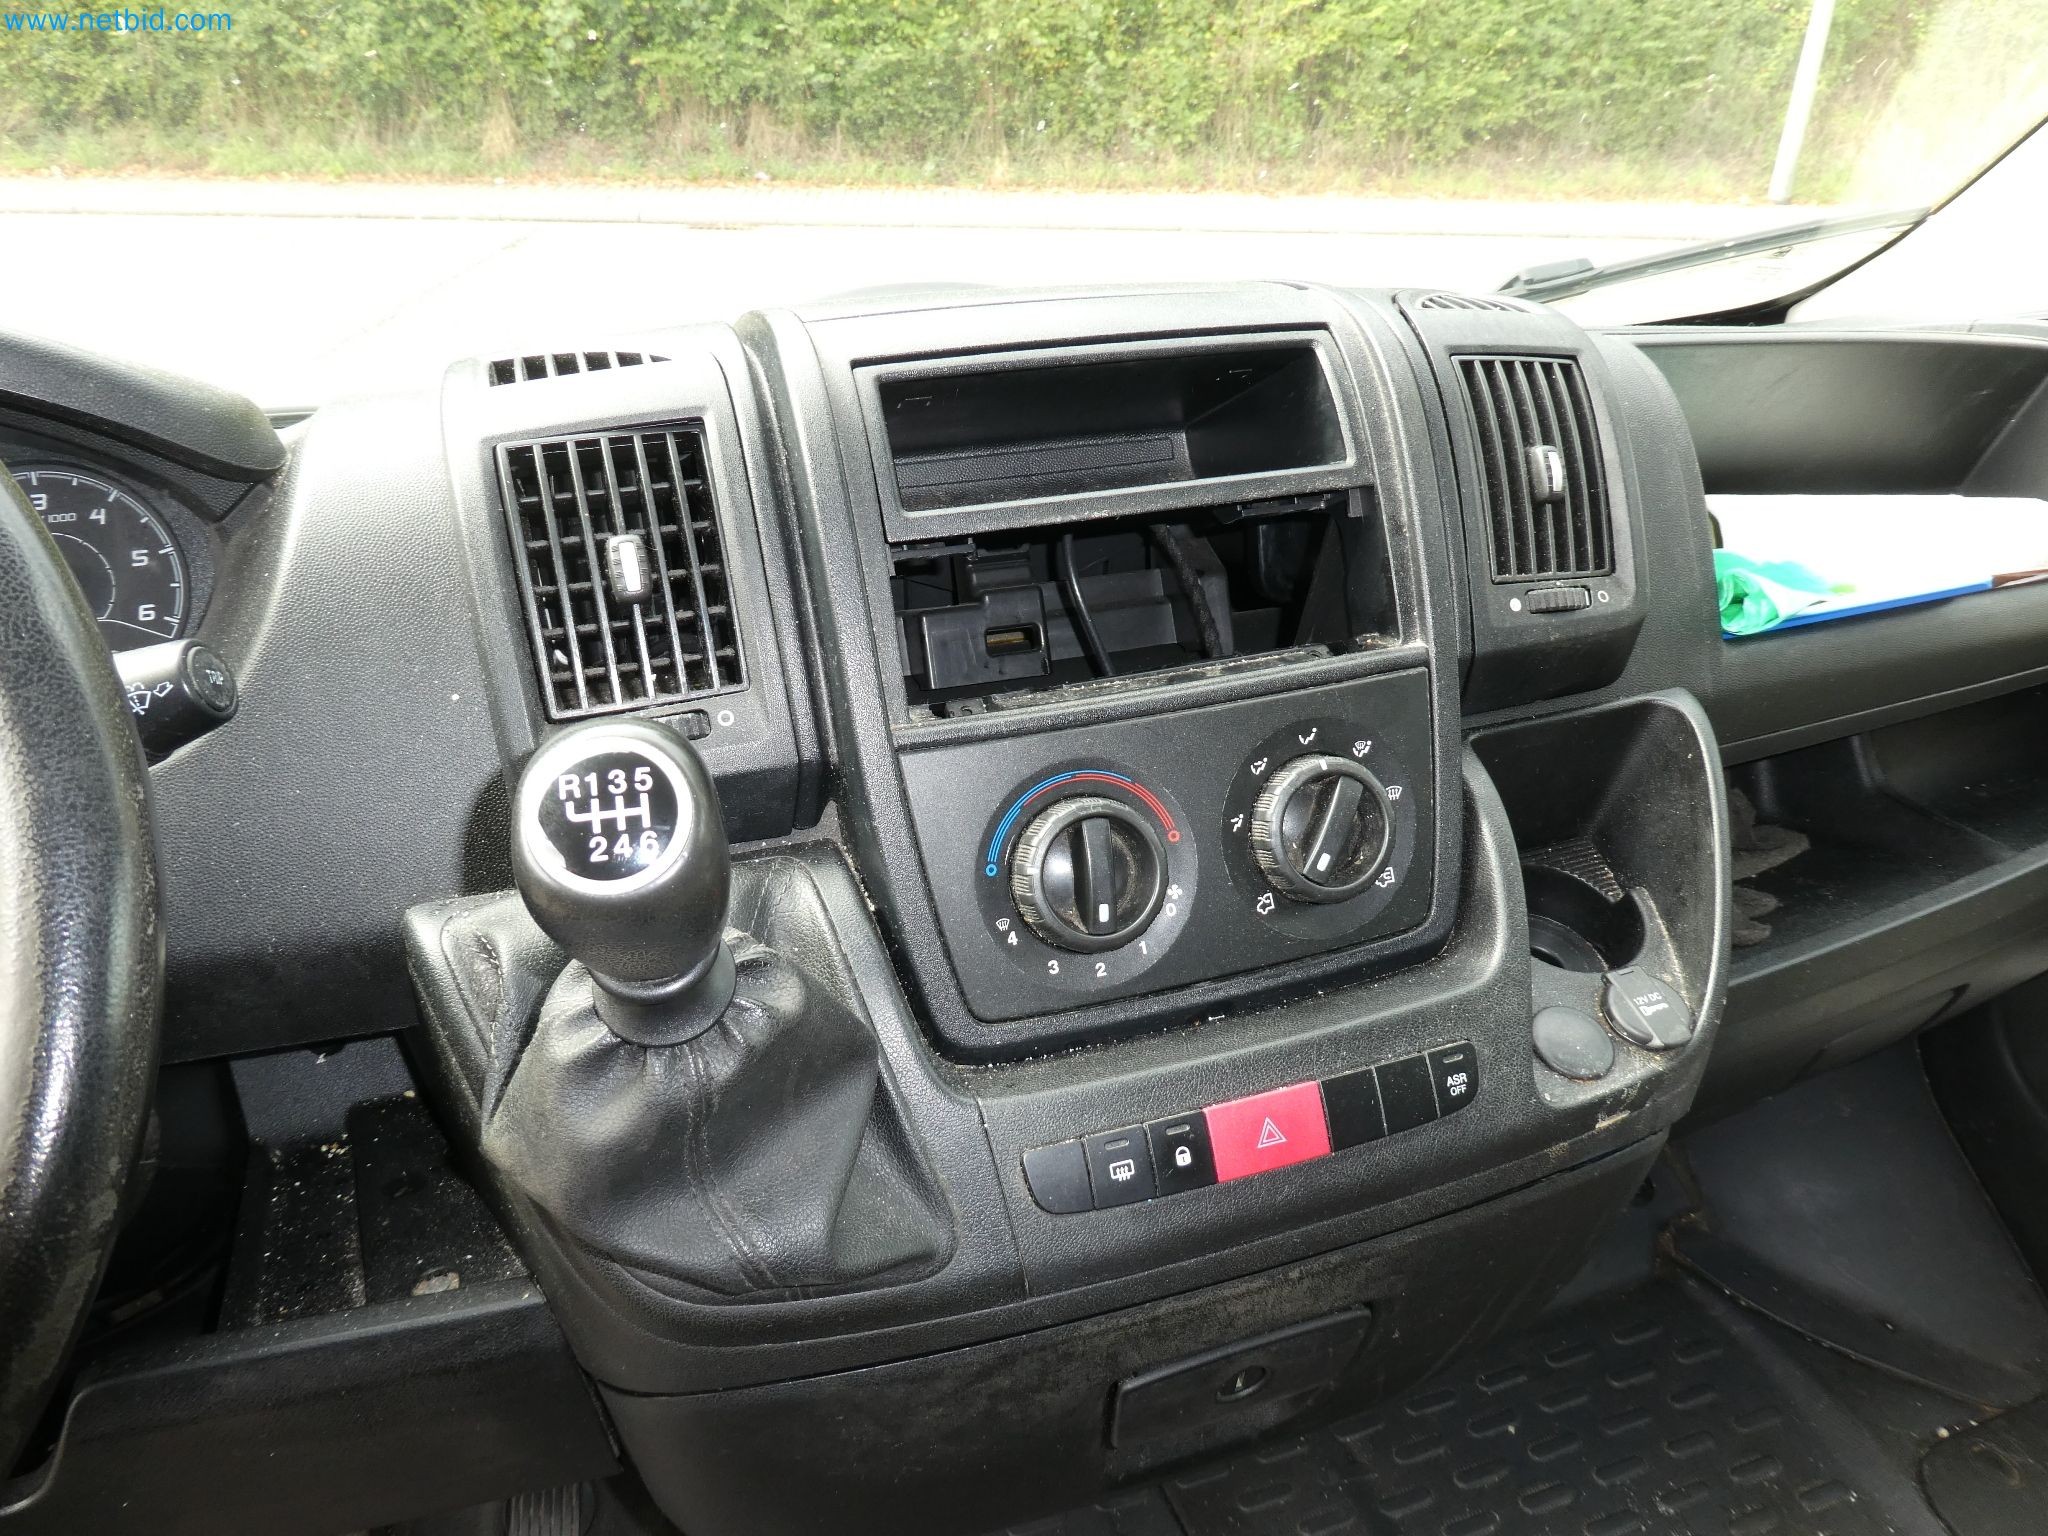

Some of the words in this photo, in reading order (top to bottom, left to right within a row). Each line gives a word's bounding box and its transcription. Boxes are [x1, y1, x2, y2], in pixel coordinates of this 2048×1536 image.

[29, 493, 48, 511] 3
[88, 508, 106, 525] 4
[130, 549, 150, 568] 5
[137, 603, 156, 621] 6
[1007, 930, 1019, 946] 4
[1138, 940, 1148, 955] 1
[1047, 959, 1060, 975] 3
[1095, 961, 1108, 978] 2
[1632, 994, 1649, 1006] 12V
[1649, 992, 1663, 1003] DC
[1446, 1072, 1468, 1087] ASR
[1449, 1084, 1467, 1096] OFF
